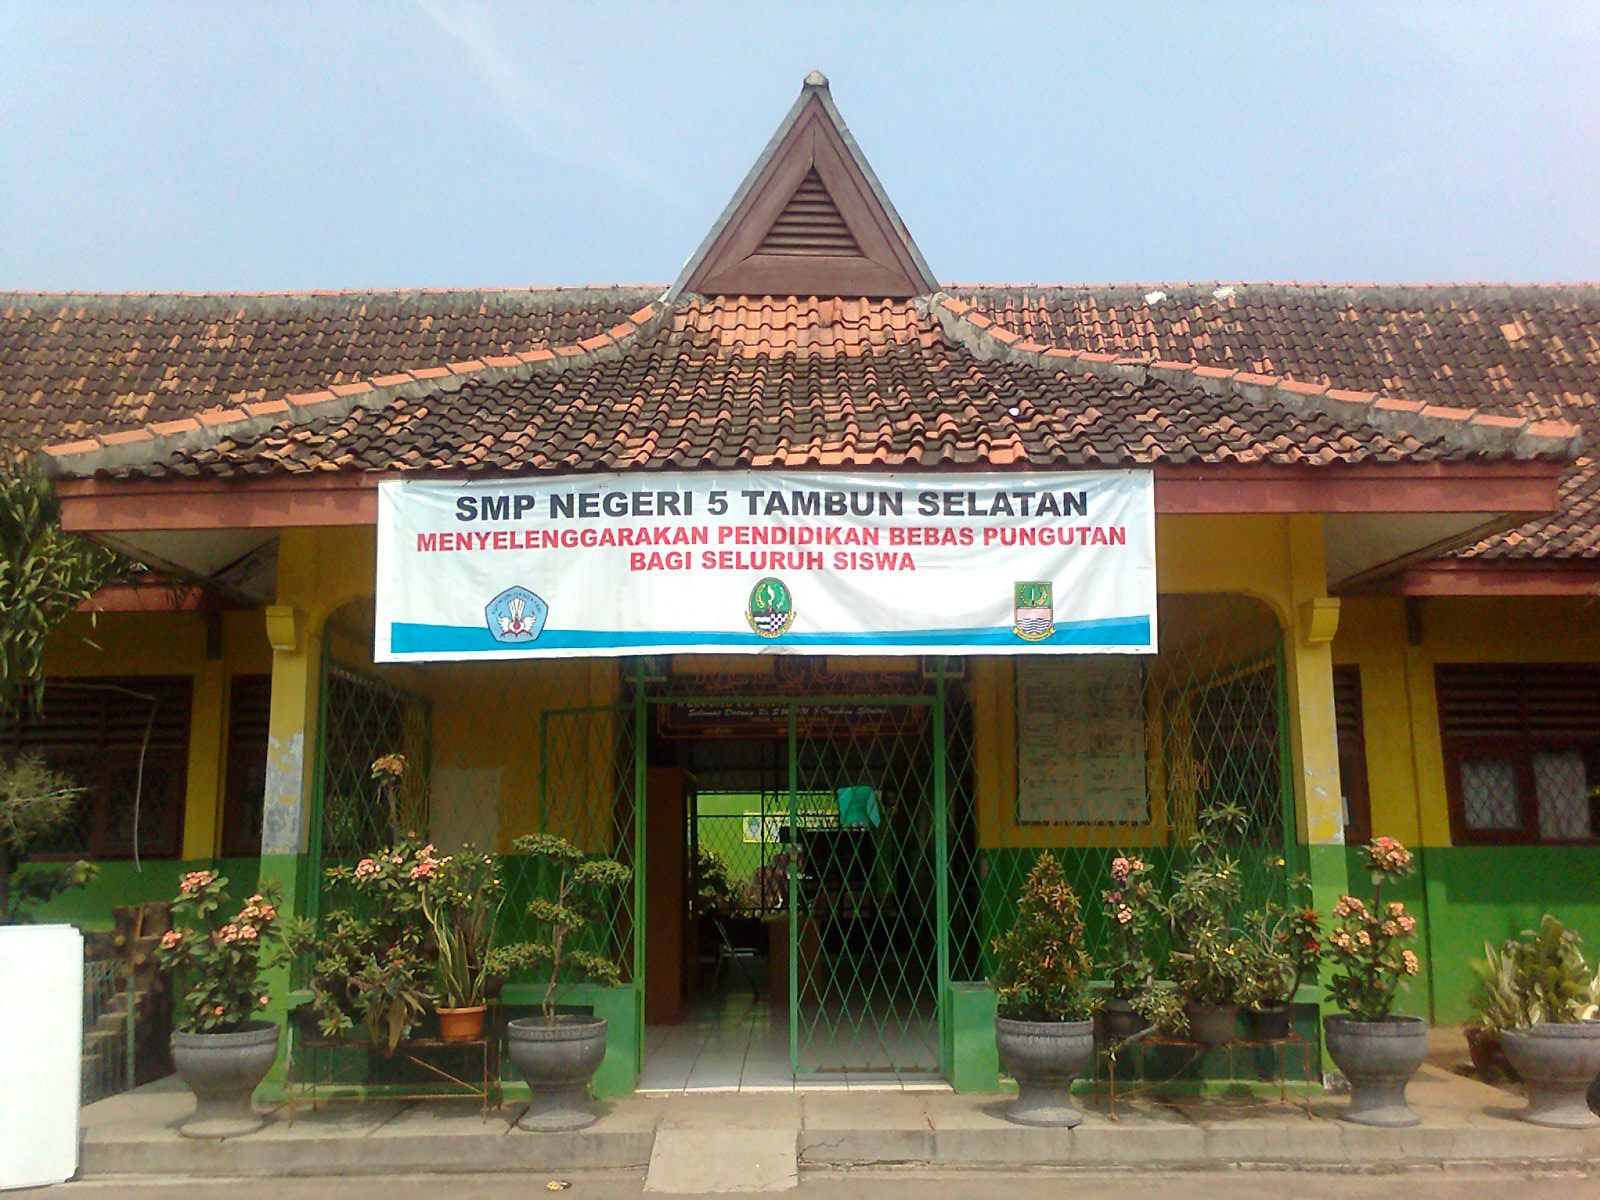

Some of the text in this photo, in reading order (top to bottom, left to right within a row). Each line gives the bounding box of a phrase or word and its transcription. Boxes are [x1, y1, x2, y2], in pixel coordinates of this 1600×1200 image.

[456, 490, 1088, 522] SMP NEGERI 5 TAMBUN SELATAN
[417, 526, 1126, 552] MENYELENGGARAKAN PENDIDIKAN BEBAS PUNGUTAN
[630, 550, 916, 571] BAGI SELURUH SISWA
